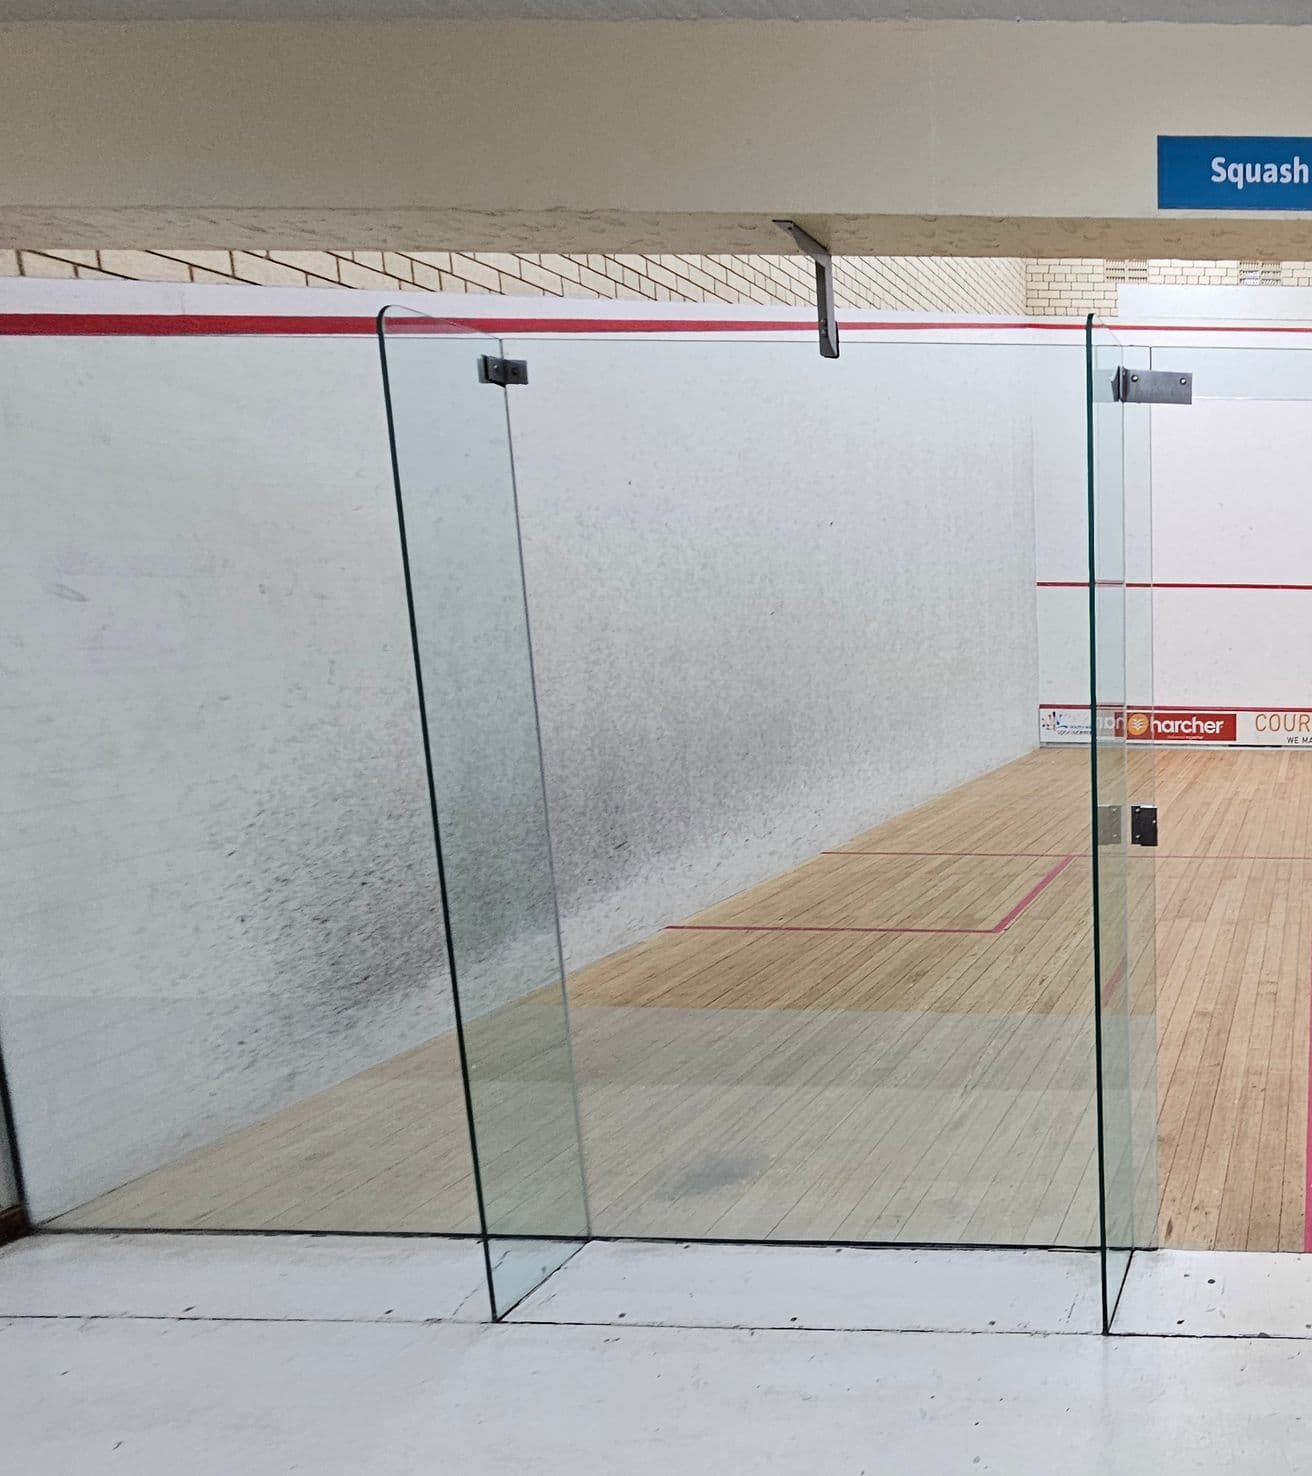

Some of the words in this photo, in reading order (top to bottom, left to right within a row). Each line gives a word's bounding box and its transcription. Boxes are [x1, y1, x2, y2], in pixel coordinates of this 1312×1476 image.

[1210, 156, 1309, 189] Squash
[1151, 716, 1225, 734] harcher
[1287, 736, 1299, 744] WE
